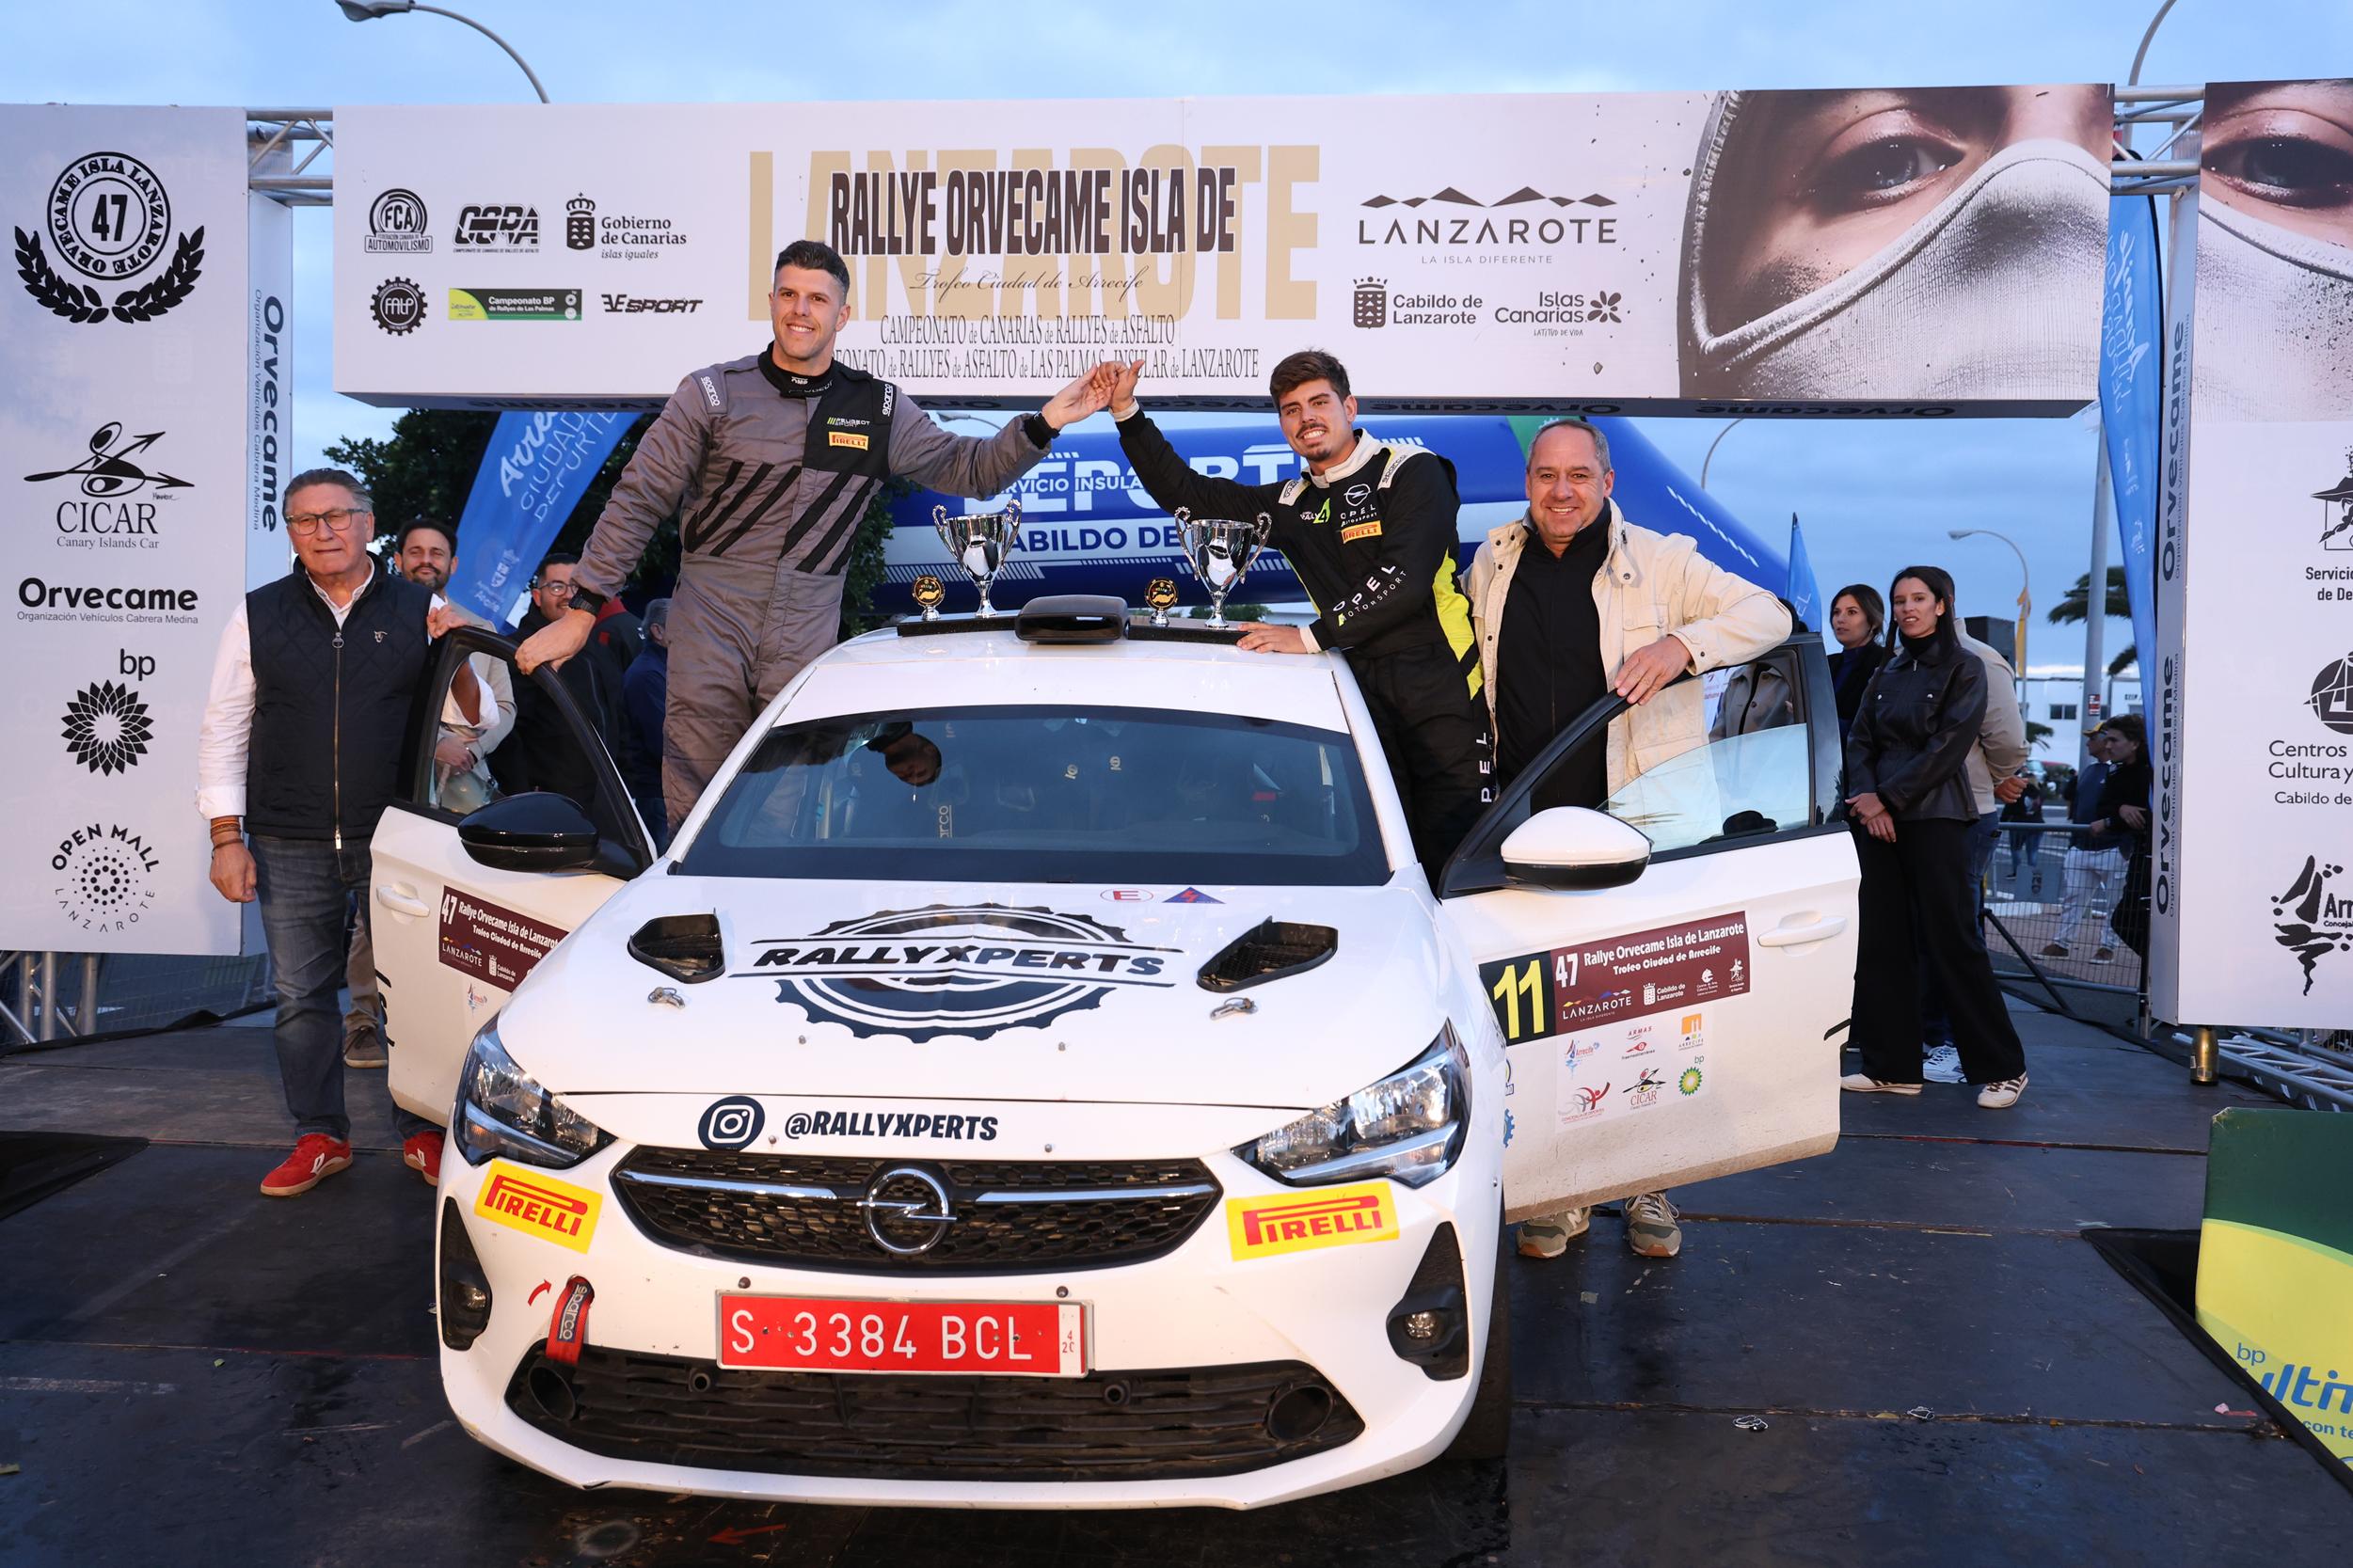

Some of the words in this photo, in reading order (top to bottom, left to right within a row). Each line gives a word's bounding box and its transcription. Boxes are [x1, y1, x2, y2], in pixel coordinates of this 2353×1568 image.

[79, 157, 126, 177] ISLA
[54, 170, 107, 274] ORVECAME
[91, 194, 128, 242] 47
[113, 166, 165, 274] LANZAROTE
[385, 204, 413, 230] FCA
[601, 216, 672, 230] Gobierno
[832, 170, 937, 256] RALLYE
[946, 167, 1111, 256] ORVECAME
[1121, 167, 1186, 253] ISLA
[1196, 166, 1236, 253] DE
[601, 231, 618, 245] de
[621, 231, 687, 245] Canarias
[1359, 218, 1617, 245] LANZAROTE
[367, 239, 430, 251] AUTOMOVILISMO
[601, 249, 623, 259] islas
[625, 249, 659, 261] iguales
[1479, 255, 1552, 263] DIFERENTE
[909, 266, 970, 303] Trofeo
[977, 271, 1046, 290] Ciudad
[1043, 270, 1062, 289] de
[1068, 265, 1150, 303] Arrecife
[488, 296, 541, 306] Campeonato
[544, 296, 555, 305] BP
[1392, 293, 1456, 309] Cabildo
[1462, 293, 1483, 309] de
[1539, 292, 1584, 307] Islas
[1392, 310, 1477, 325] Lanzarote
[1494, 307, 1584, 324] Canarias
[881, 314, 965, 344] CAMPEONATO
[969, 323, 977, 344] de
[980, 314, 1042, 344] CANARIAS
[1045, 322, 1054, 344] de
[1056, 314, 1107, 344] RALLYES
[1110, 322, 1118, 344] de
[1121, 314, 1175, 344] ASFALTO
[833, 349, 886, 378] EONATO
[888, 357, 898, 378] de
[899, 349, 950, 378] RALLYES
[952, 357, 962, 378] de
[964, 349, 1016, 378] ASFALTO
[1020, 356, 1027, 378] de
[1031, 349, 1054, 378] LAS
[1170, 356, 1179, 378] de
[1182, 348, 1259, 378] LANZAROTE
[701, 376, 721, 406] sparco
[882, 384, 894, 417] sparco
[263, 295, 284, 532] Orvecame
[832, 435, 866, 447] PIRELLI
[2163, 321, 2185, 581] Orvecame
[1074, 475, 1144, 491] INSULA
[56, 500, 158, 534] CICAR
[1340, 504, 1375, 519] OPEL
[56, 536, 96, 549] Canary
[100, 537, 137, 548] Islands
[140, 538, 160, 548] Car
[1011, 526, 1127, 553] ABILDO
[1138, 525, 1182, 548] DE
[1343, 525, 1377, 540] PIRELLI
[18, 577, 199, 611] Orvecame
[1332, 564, 1396, 612] OPEL
[2318, 587, 2333, 600] de
[2337, 587, 2353, 600] De
[17, 610, 77, 623] Organización
[79, 611, 124, 624] Vehículos
[126, 613, 163, 625] Cabrera
[166, 614, 199, 625] Medina
[119, 648, 156, 681] bp
[2269, 740, 2346, 757] Centros
[1476, 732, 1492, 803] PEL
[2268, 762, 2341, 779] Cultura
[2343, 767, 2353, 784] y
[2156, 656, 2173, 915] Orvecame
[2275, 791, 2329, 805] Cabildo
[2335, 791, 2352, 805] de
[51, 823, 103, 871] OPEN
[111, 823, 159, 873] MALL
[1112, 890, 1142, 901] E
[55, 887, 155, 934] LANZAROTE
[442, 894, 457, 925] 47
[459, 901, 478, 921] Rallye
[478, 909, 508, 931] Orvecame
[508, 921, 519, 936] Isla
[520, 926, 529, 939] de
[529, 929, 559, 949] Lanzarot
[472, 925, 489, 939] Trofeo
[442, 943, 483, 967] LANZAROTE
[753, 945, 1165, 975] RALLYXPERTS
[1556, 953, 1579, 988] 47
[1584, 946, 1614, 967] Rallye
[1616, 939, 1665, 959] Orvecame
[1666, 935, 1684, 949] Isla
[1685, 931, 1697, 945] de
[1697, 922, 1744, 942] Lanzarote
[1613, 961, 1641, 975] Trofeo
[1643, 956, 1675, 970] Ciudad
[1677, 953, 1687, 961] de
[1688, 944, 1721, 959] Arrecife
[1494, 959, 1545, 1039] 11
[1656, 984, 1677, 995] Cabildo
[1656, 991, 1684, 1002] Lanzarote
[1563, 996, 1632, 1021] LANZAROTE
[1628, 1025, 1653, 1037] ARMAS
[1694, 1055, 1705, 1065] bp
[1630, 1091, 1658, 1106] CICAR
[785, 1110, 999, 1140] @RALLYXPERTS
[485, 1174, 589, 1237] PIRELLI
[1243, 1195, 1383, 1246] PIRELLI
[559, 1283, 587, 1339] sparco
[731, 1309, 755, 1355] S
[794, 1311, 917, 1360] 3384
[941, 1314, 1033, 1362] BCL
[2236, 1342, 2266, 1366] bp
[2303, 1420, 2334, 1435] con
